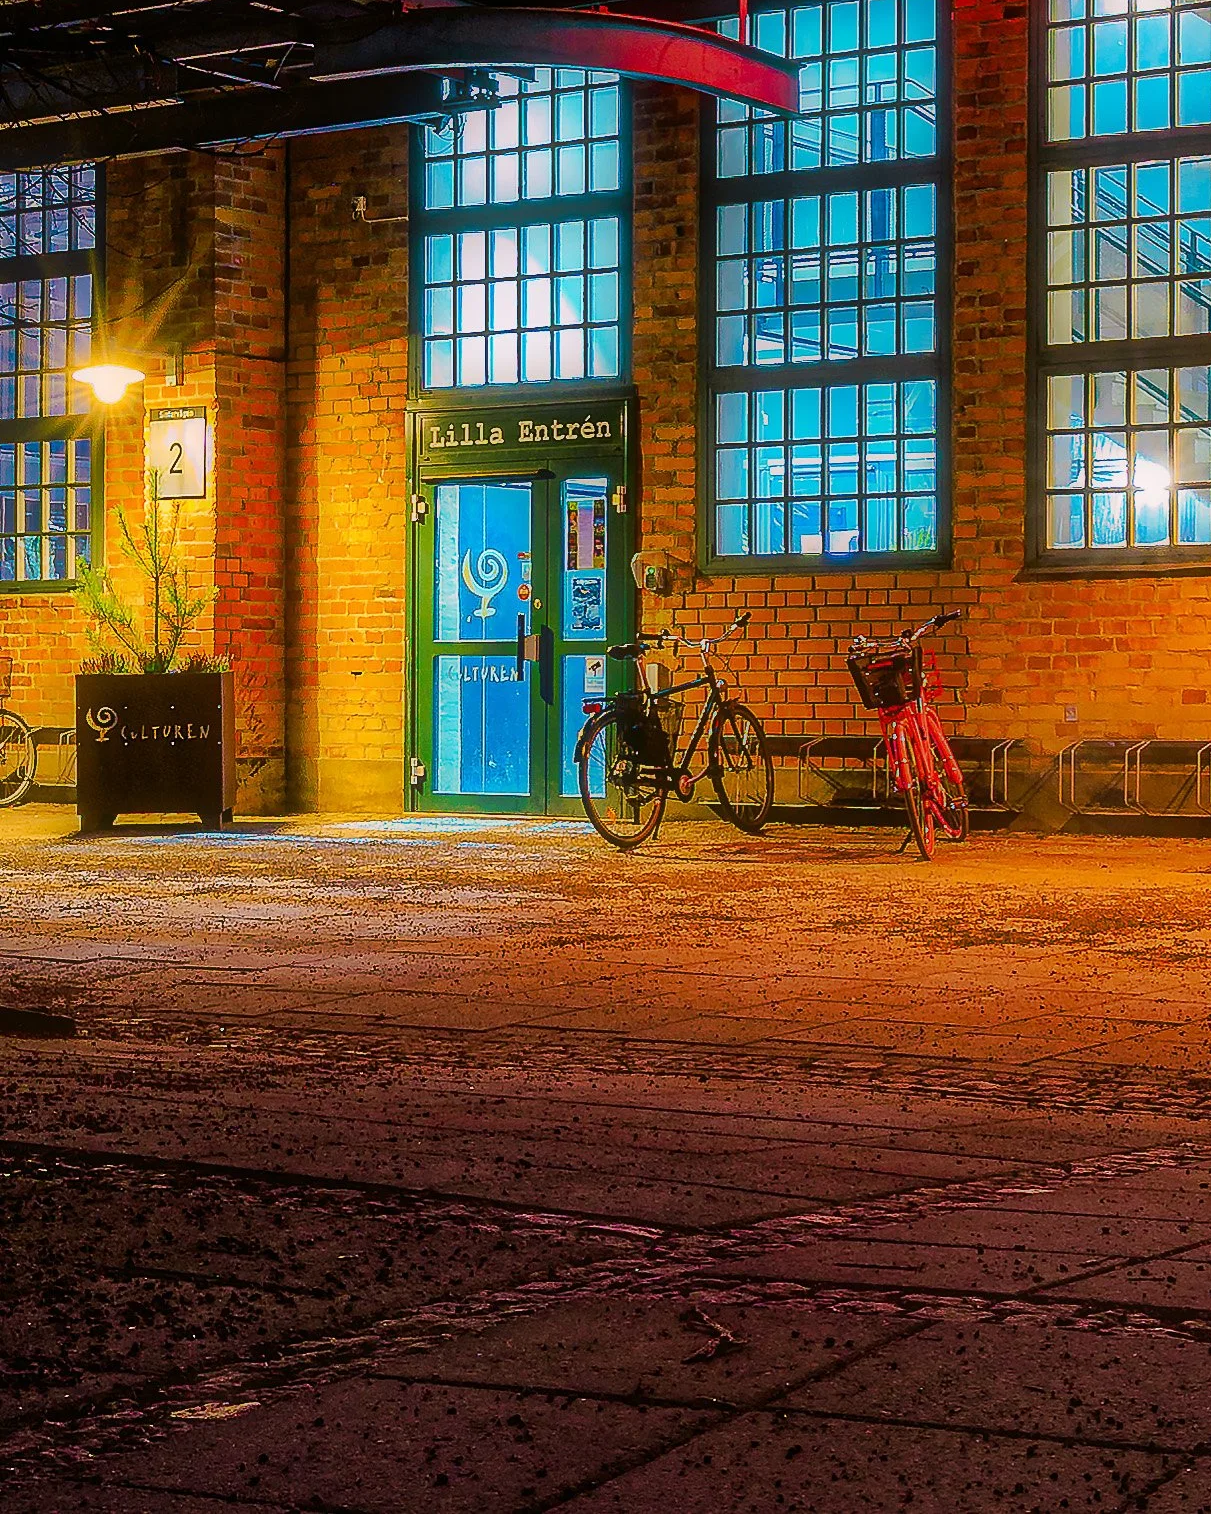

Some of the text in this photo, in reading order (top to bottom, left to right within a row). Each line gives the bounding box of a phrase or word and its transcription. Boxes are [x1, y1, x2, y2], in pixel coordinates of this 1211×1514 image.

[429, 415, 612, 448] Lilla Entrén
[169, 442, 183, 474] 2
